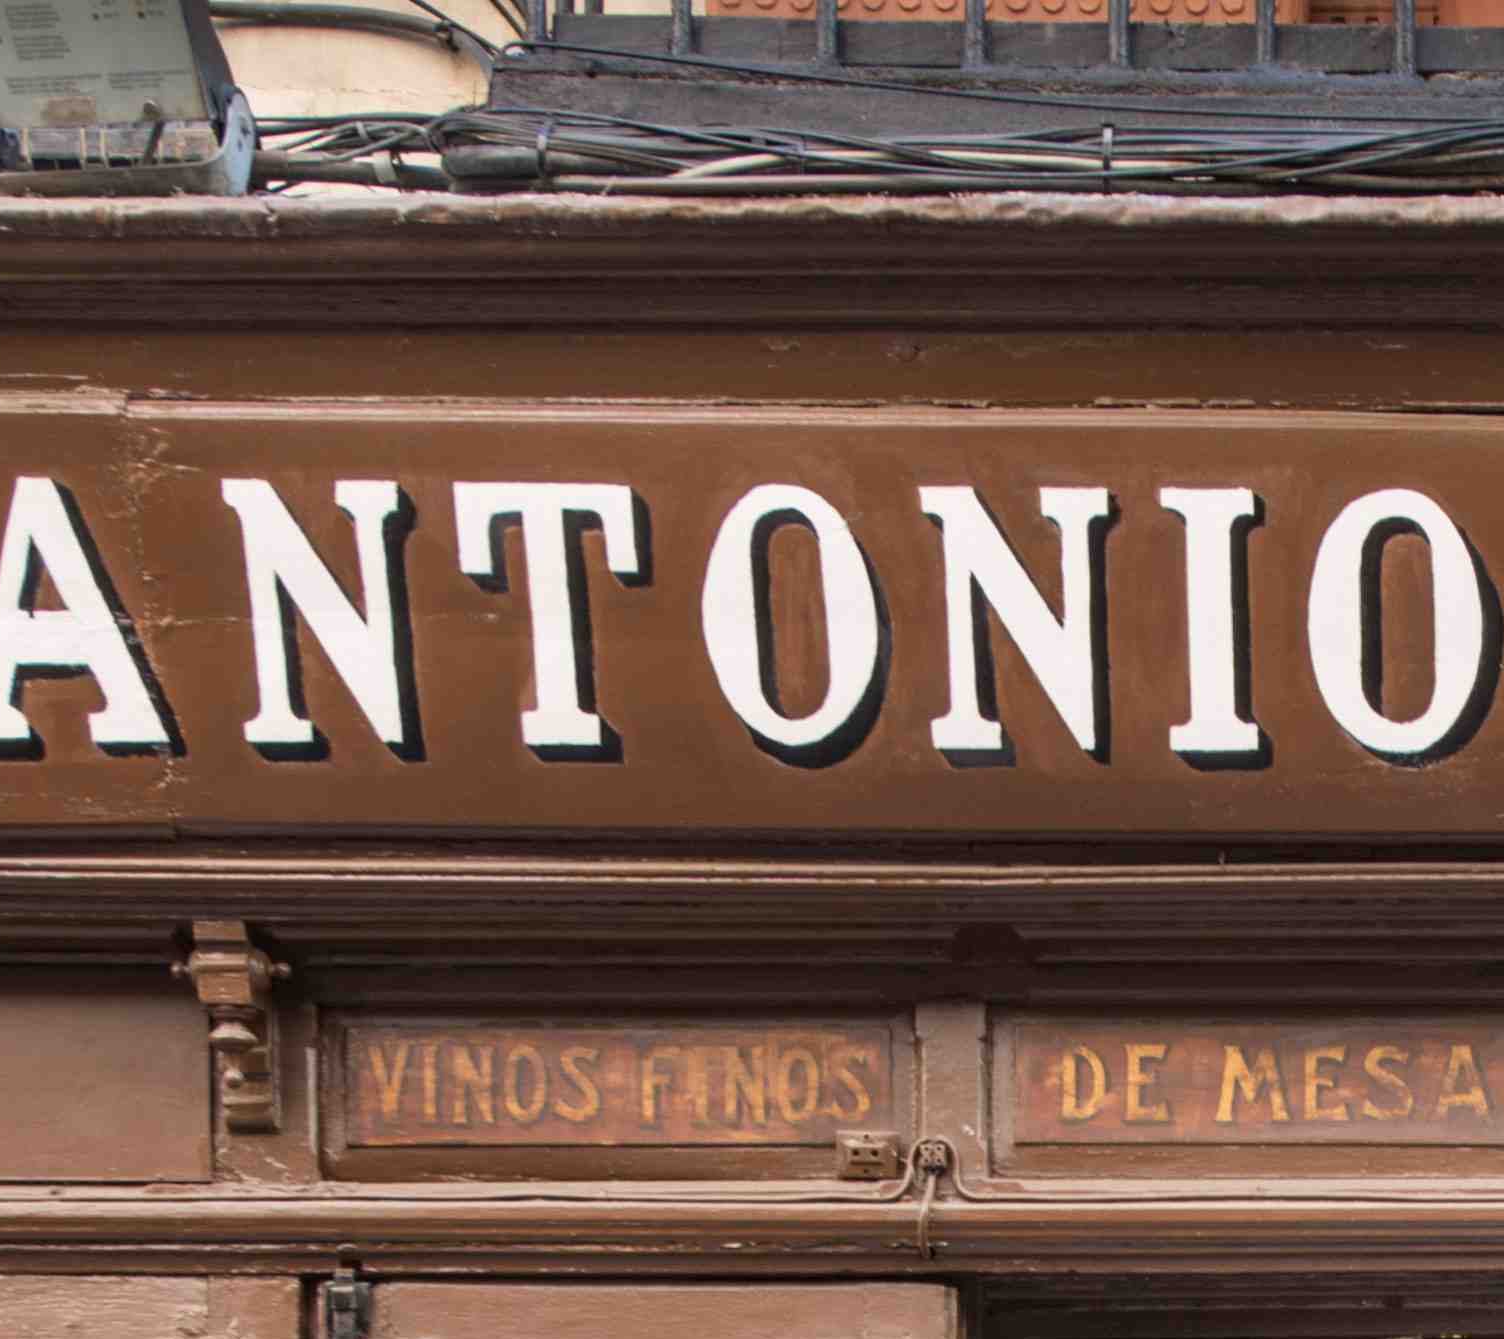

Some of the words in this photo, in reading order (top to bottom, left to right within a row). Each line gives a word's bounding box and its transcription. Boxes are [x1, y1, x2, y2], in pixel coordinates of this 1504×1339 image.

[368, 1038, 602, 1126] VINOS
[639, 1038, 883, 1126] FINOS
[1061, 1043, 1175, 1126] DE
[1215, 1042, 1498, 1126] MESA
